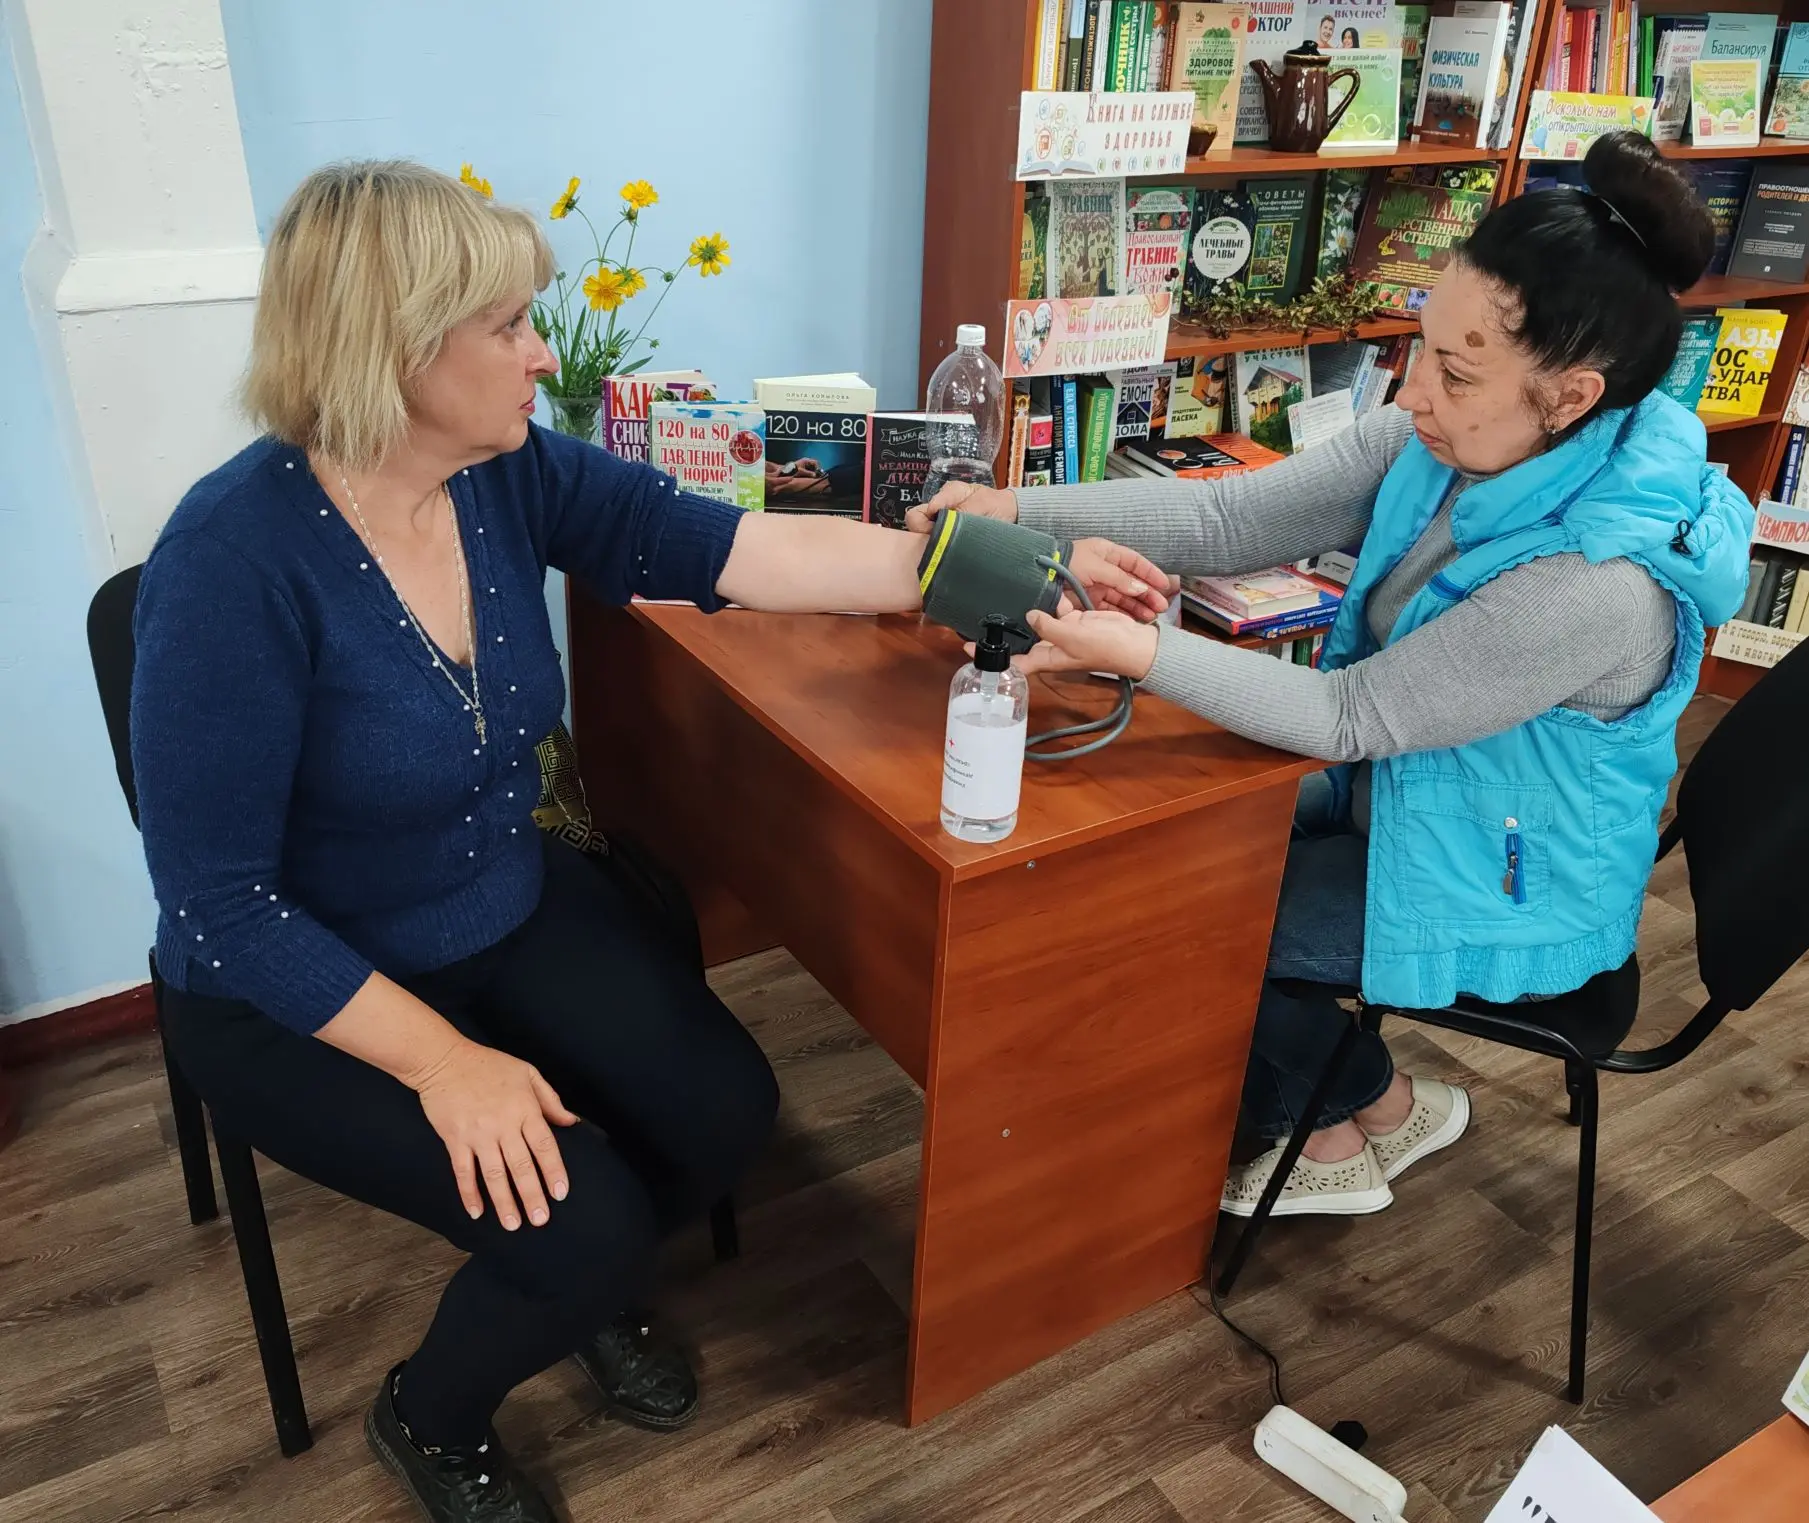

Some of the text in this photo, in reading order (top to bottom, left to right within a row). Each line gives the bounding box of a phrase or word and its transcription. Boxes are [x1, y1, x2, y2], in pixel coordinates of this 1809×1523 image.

[1334, 7, 1387, 19] вкуснее!
[1711, 39, 1767, 57] Балансируя
[1189, 58, 1234, 68] ЗДОРОВОЕ
[1432, 49, 1480, 67] ФИЗИЧЕСКАЯ
[1185, 69, 1213, 77] ПИТАНИЕ
[1428, 72, 1464, 89] КУЛЬТУРА
[1546, 99, 1617, 118] О сколько нам
[1064, 195, 1113, 213] ТРАВНИК
[1757, 191, 1793, 200] РОДИТЕЛЕЙ
[1438, 200, 1483, 223] АТЛАС
[1199, 238, 1245, 249] ЛЕЧЕБНЫЕ
[1390, 229, 1453, 248] РАСТЕНИЙ
[1126, 246, 1178, 277] ТРАВНИК
[1205, 249, 1236, 259] ТРАВЫ
[1245, 350, 1300, 363] УЧАСТОК
[1714, 348, 1748, 368] ОС
[1719, 367, 1771, 386] УДАР
[611, 381, 655, 419] КАК
[1700, 386, 1741, 401] ТВА
[766, 415, 867, 437] 120 на 80
[1053, 405, 1063, 448] АНАТОМИЯ
[1171, 414, 1198, 423] ПАСЕКА
[658, 419, 729, 441] 120 на 80
[892, 431, 917, 443] НАУКА
[1067, 416, 1076, 448] СТРЕССА
[660, 447, 727, 467] ДАВЛЕНИЕ
[684, 465, 733, 485] норме!
[696, 486, 724, 494] ПРОБЛЕМУ
[1279, 623, 1307, 635] РОШАЛЬ
